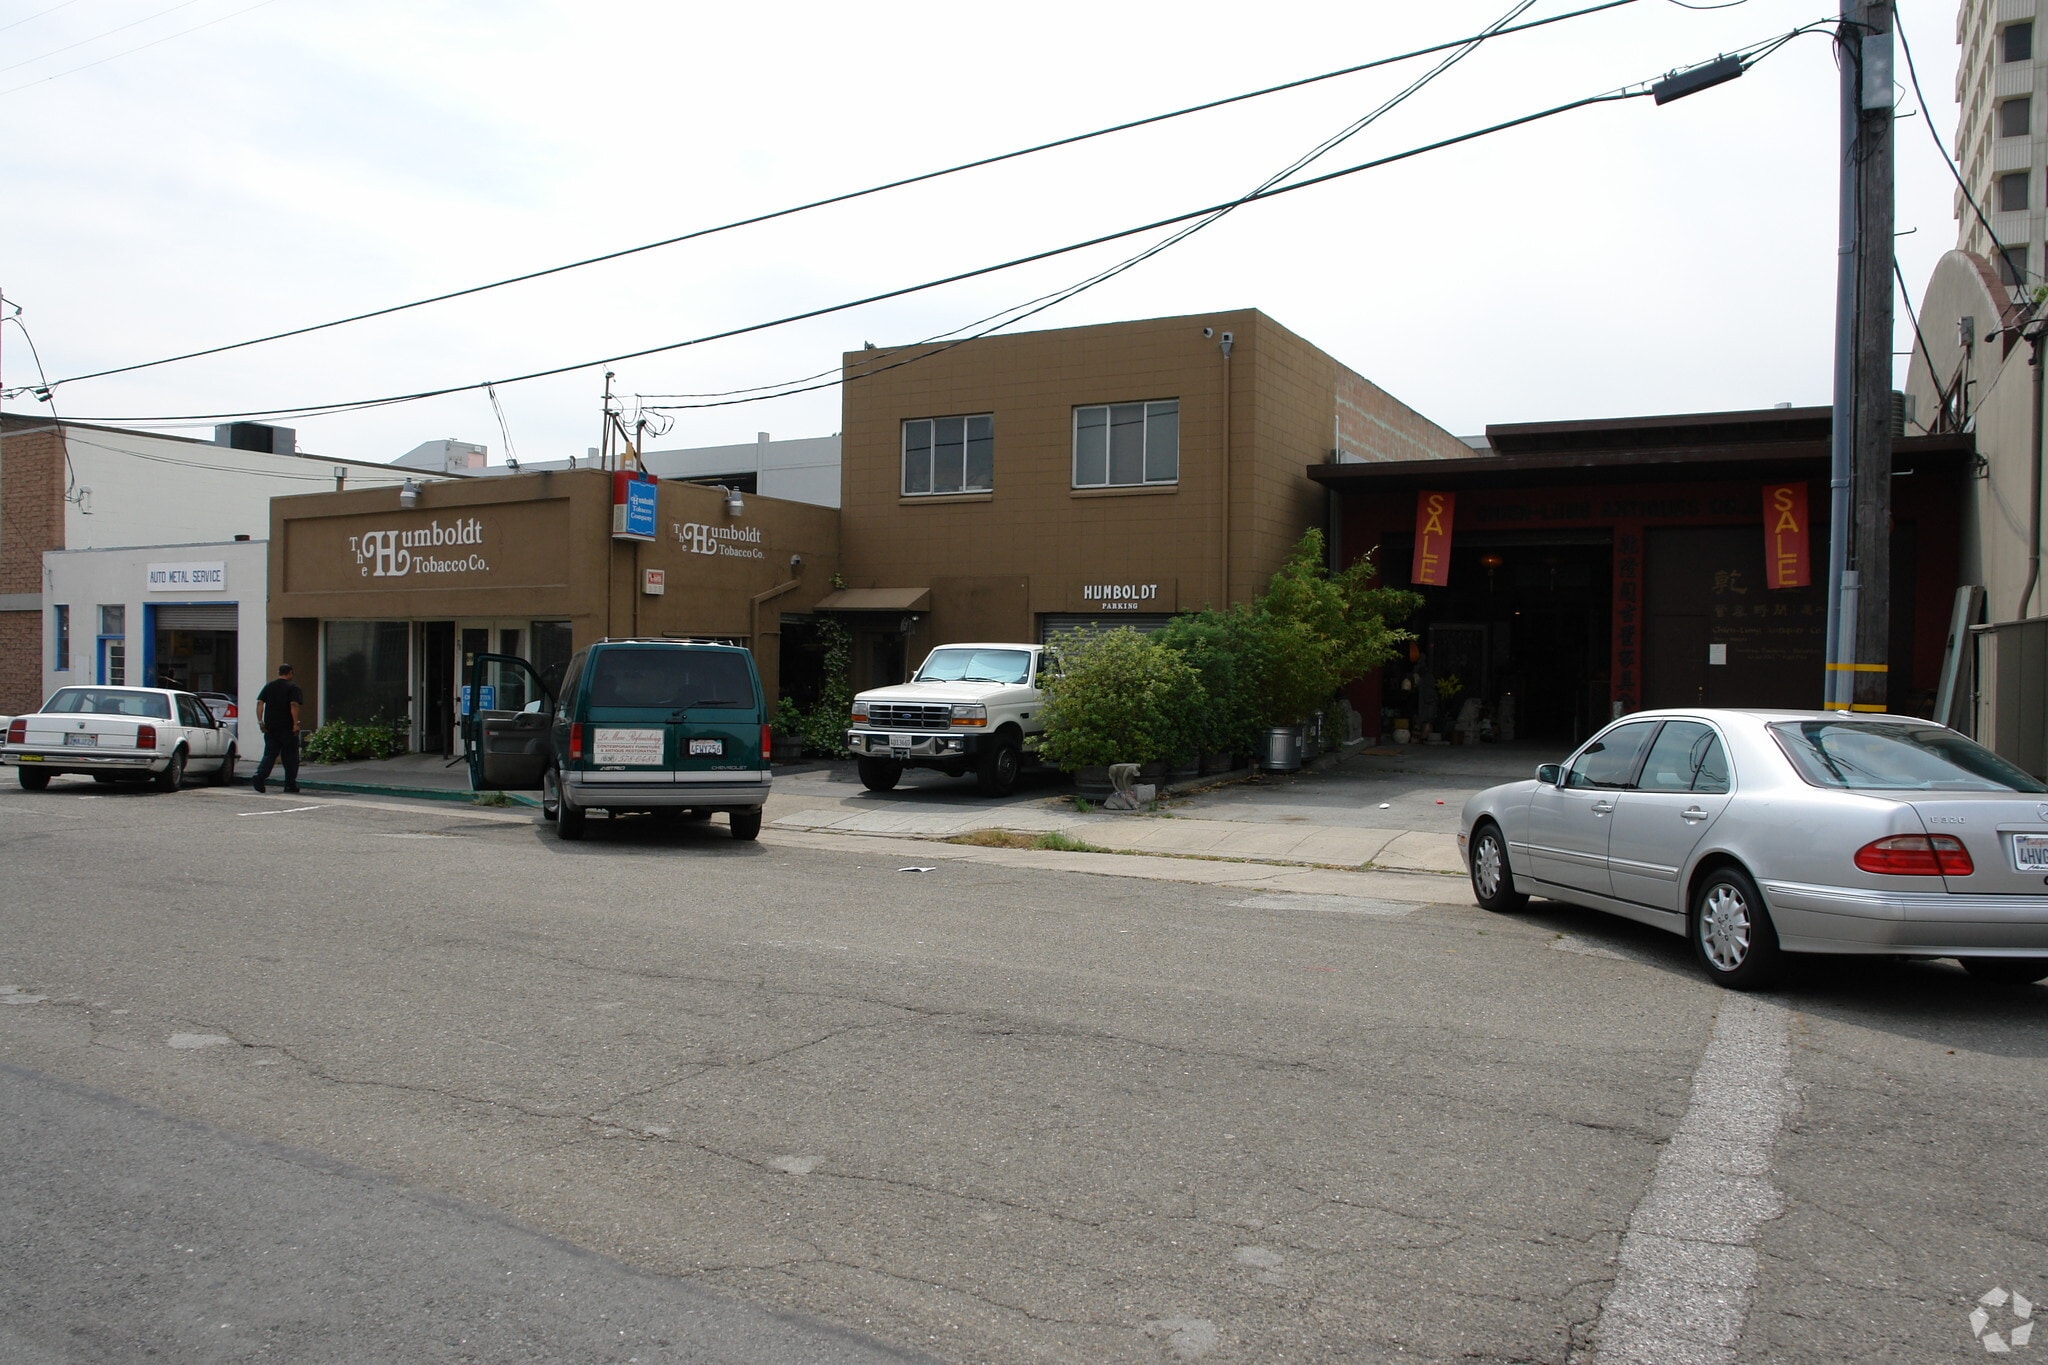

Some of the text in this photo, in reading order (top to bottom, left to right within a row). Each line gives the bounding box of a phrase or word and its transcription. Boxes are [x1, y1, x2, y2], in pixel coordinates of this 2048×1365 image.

[683, 523, 761, 555] Humboldt
[1420, 495, 1444, 583] SALE
[1774, 488, 1799, 585] SALE
[362, 518, 482, 576] Humboldt
[719, 544, 765, 559] Tobacco Co.
[413, 554, 489, 573] Tobacco Co.
[149, 569, 222, 584] AUTO METAL SERVICE
[1084, 584, 1158, 600] HUMBOLDT
[1102, 602, 1138, 610] PARKING
